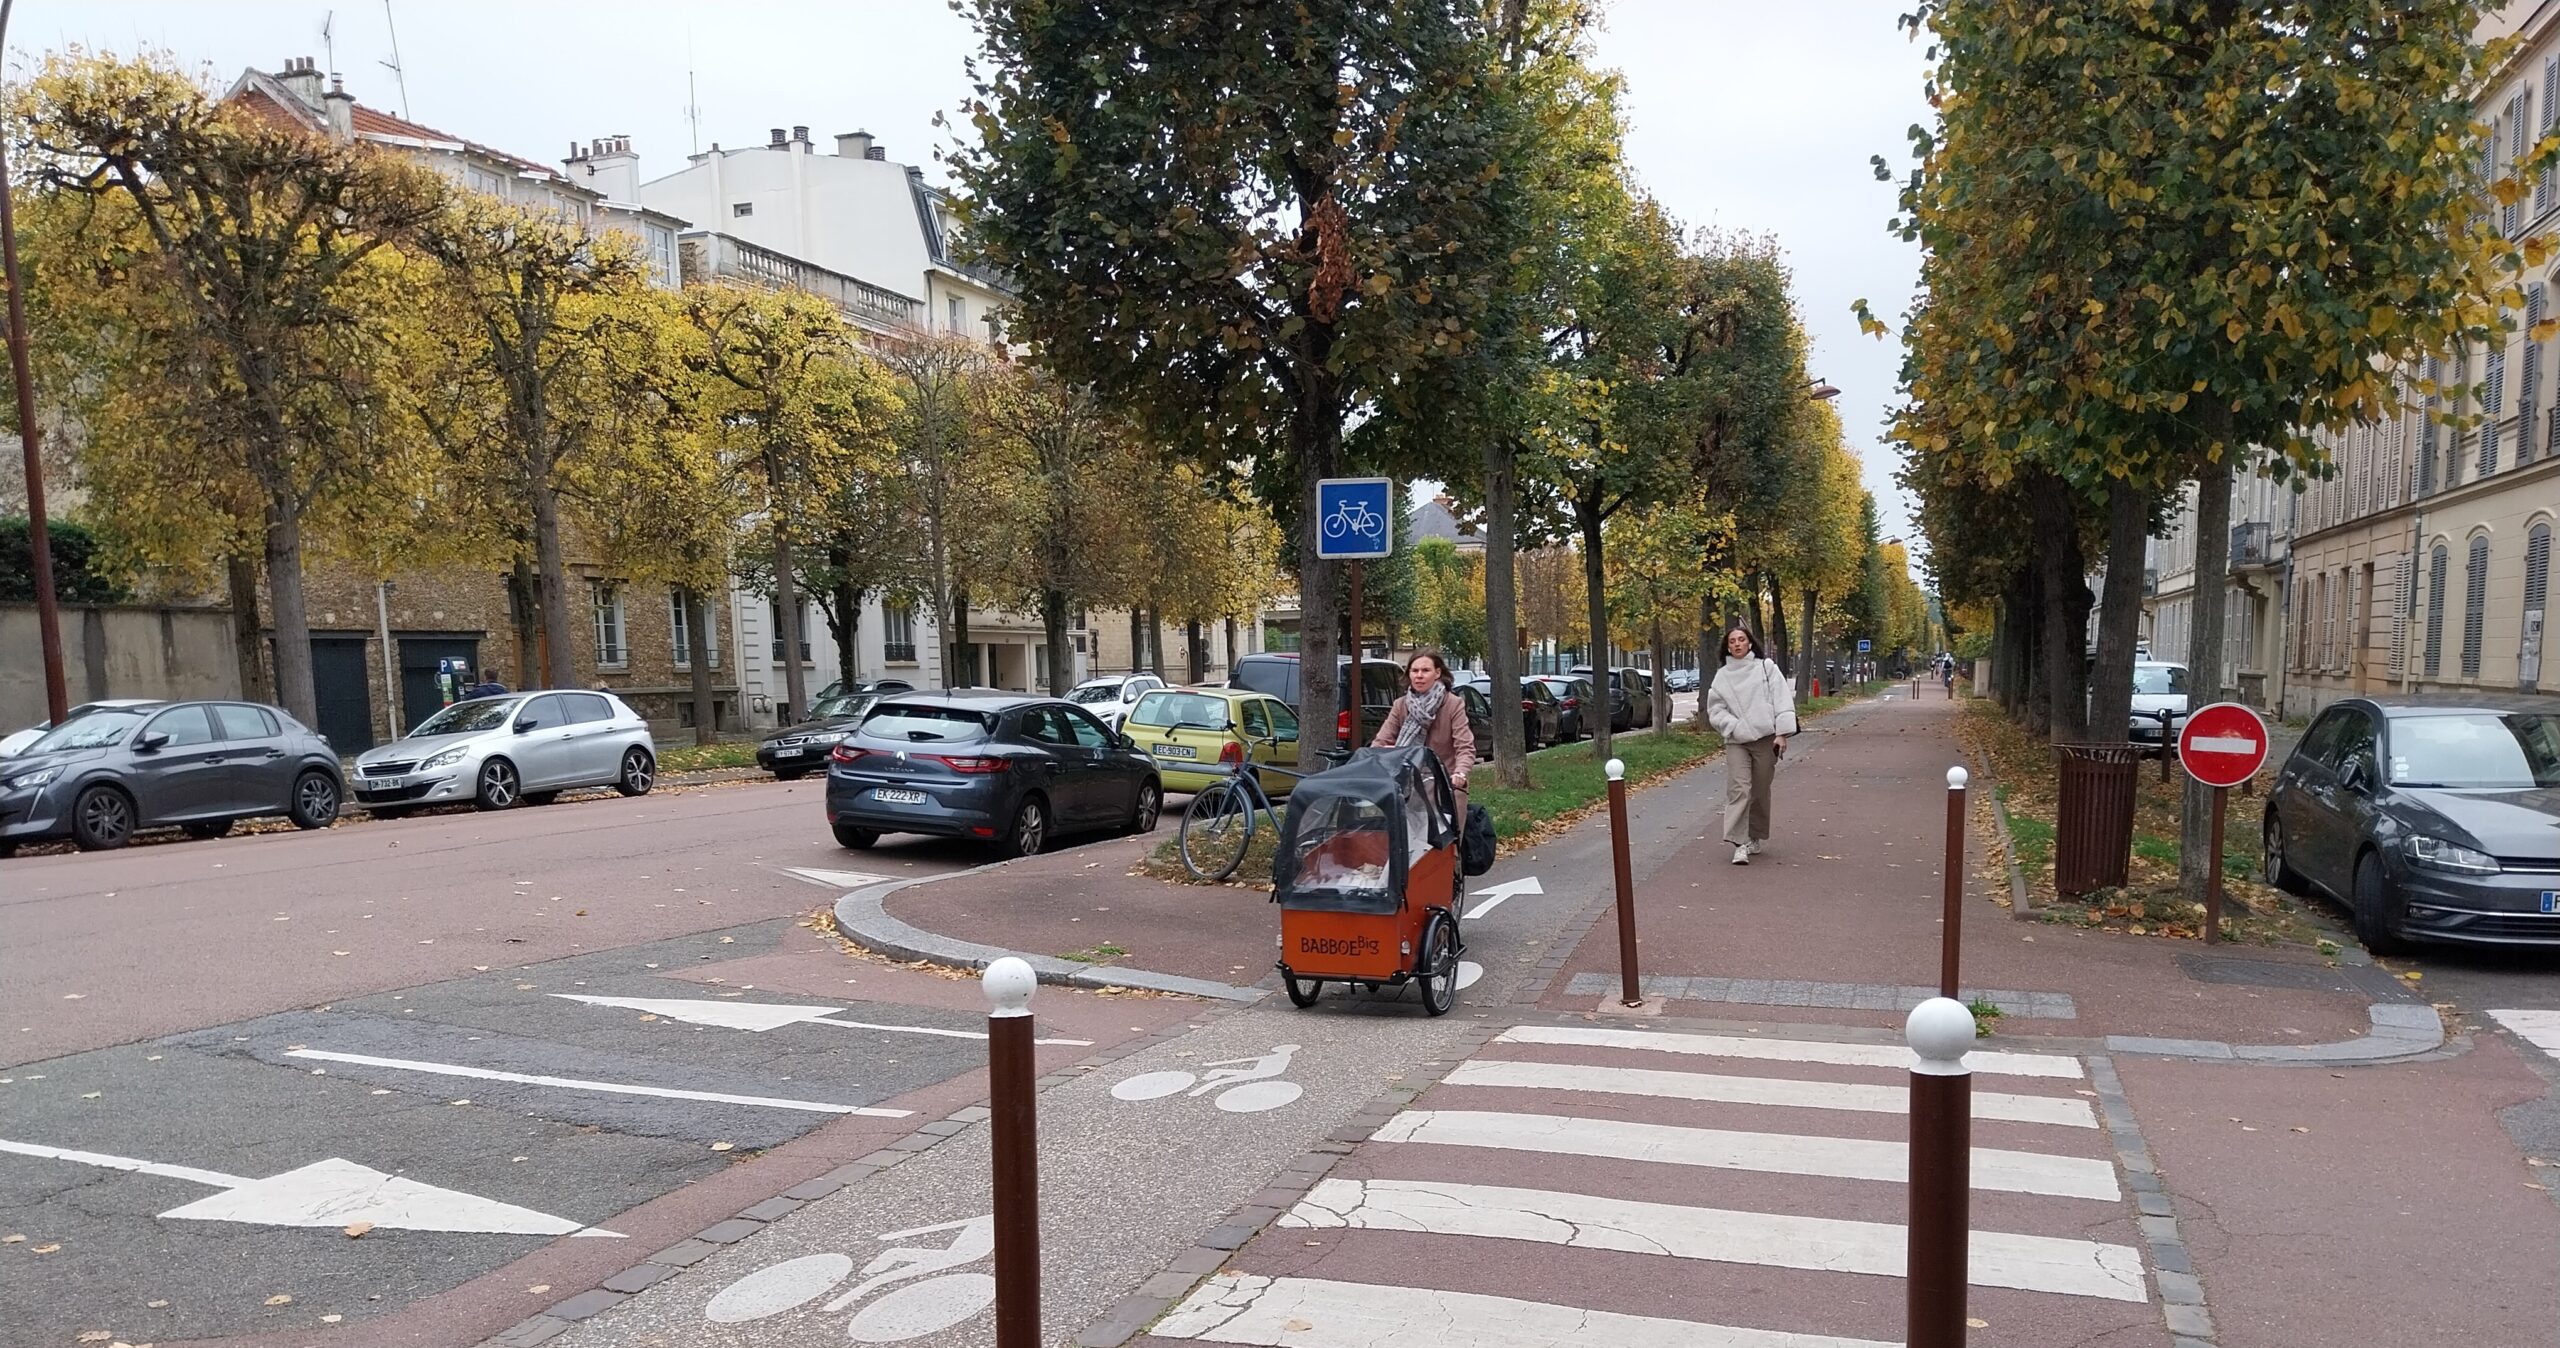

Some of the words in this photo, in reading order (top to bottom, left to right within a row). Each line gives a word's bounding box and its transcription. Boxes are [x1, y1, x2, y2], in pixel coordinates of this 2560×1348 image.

[440, 659, 448, 673] P
[877, 789, 920, 801] EK-222-XR
[1301, 937, 1360, 955] BABBOE
[1358, 936, 1379, 954] Big
